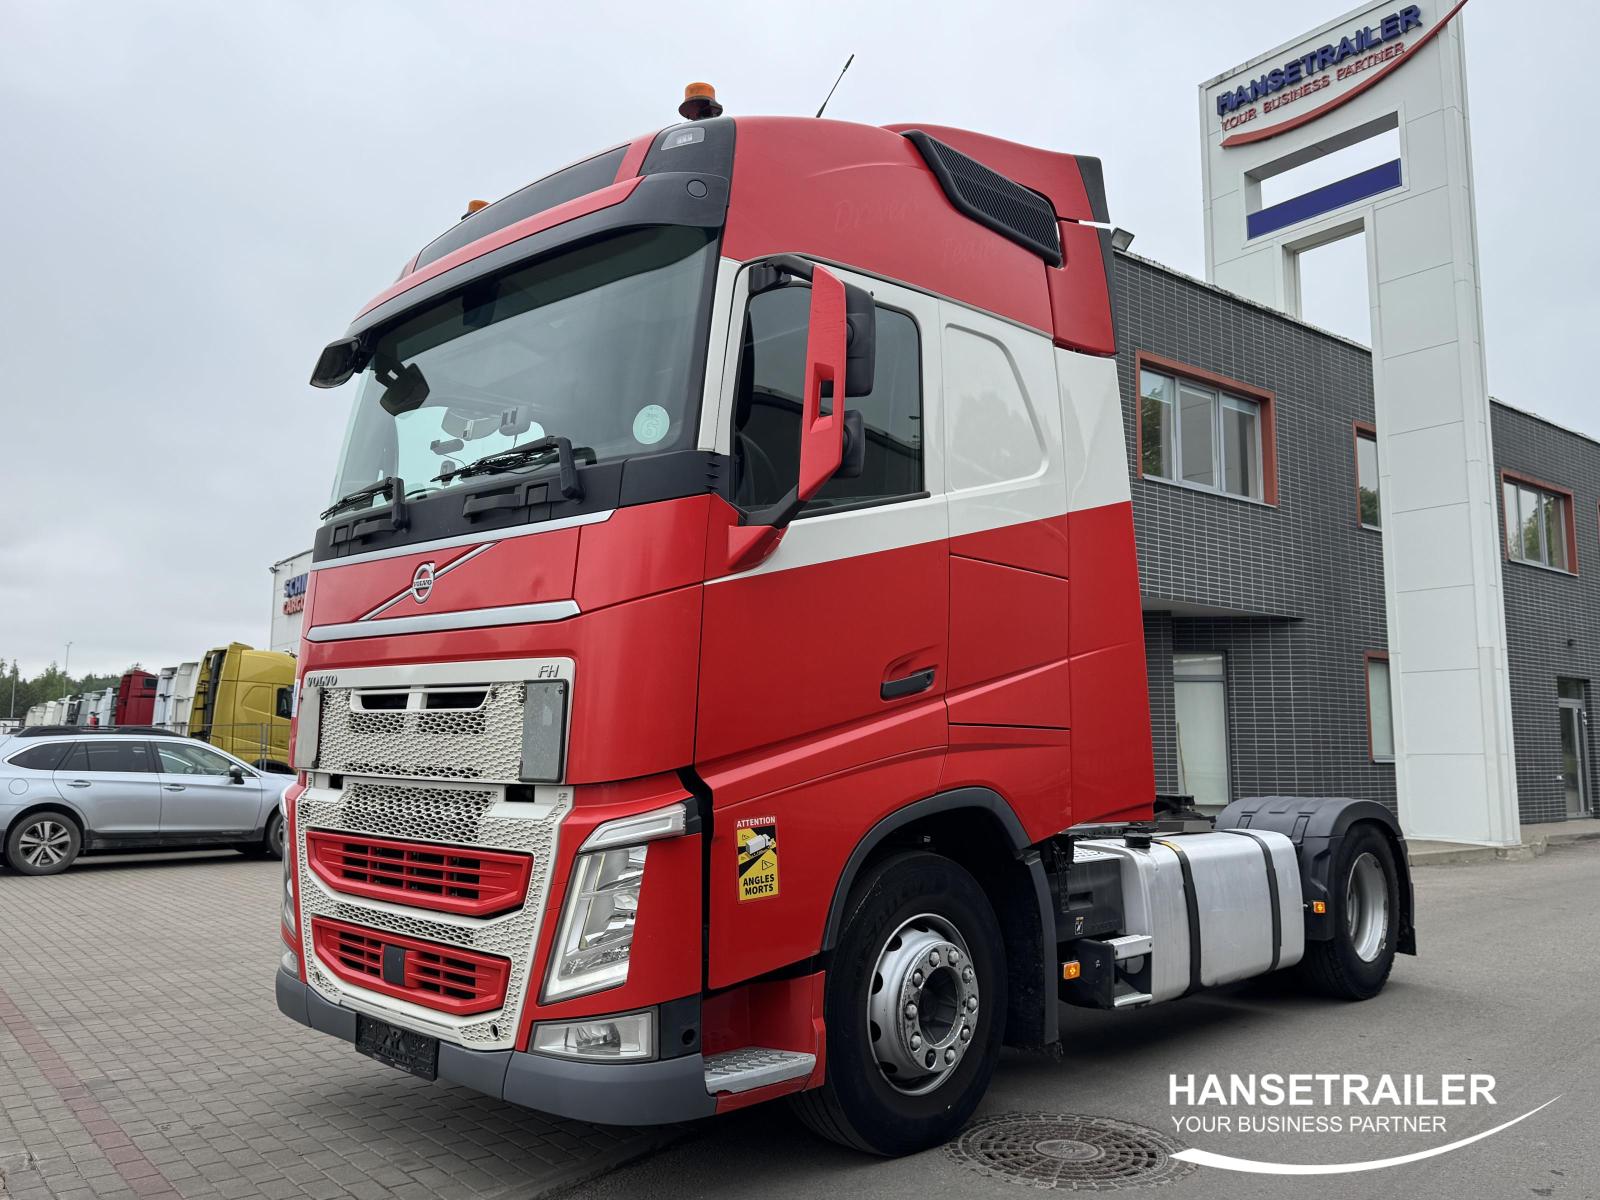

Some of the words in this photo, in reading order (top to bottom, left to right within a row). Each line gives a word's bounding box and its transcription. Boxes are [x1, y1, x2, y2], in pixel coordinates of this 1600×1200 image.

[1216, 4, 1423, 117] HANSETRAILER
[1222, 108, 1258, 132] YOUR
[1263, 75, 1331, 113] BUSINESS
[1336, 42, 1406, 81] PARTNER
[414, 579, 433, 587] VOLVO
[538, 664, 560, 678] FH
[307, 674, 338, 687] VOLVO
[736, 816, 776, 827] ATTENTION
[743, 873, 775, 887] ANGLES
[745, 883, 774, 896] MORTS
